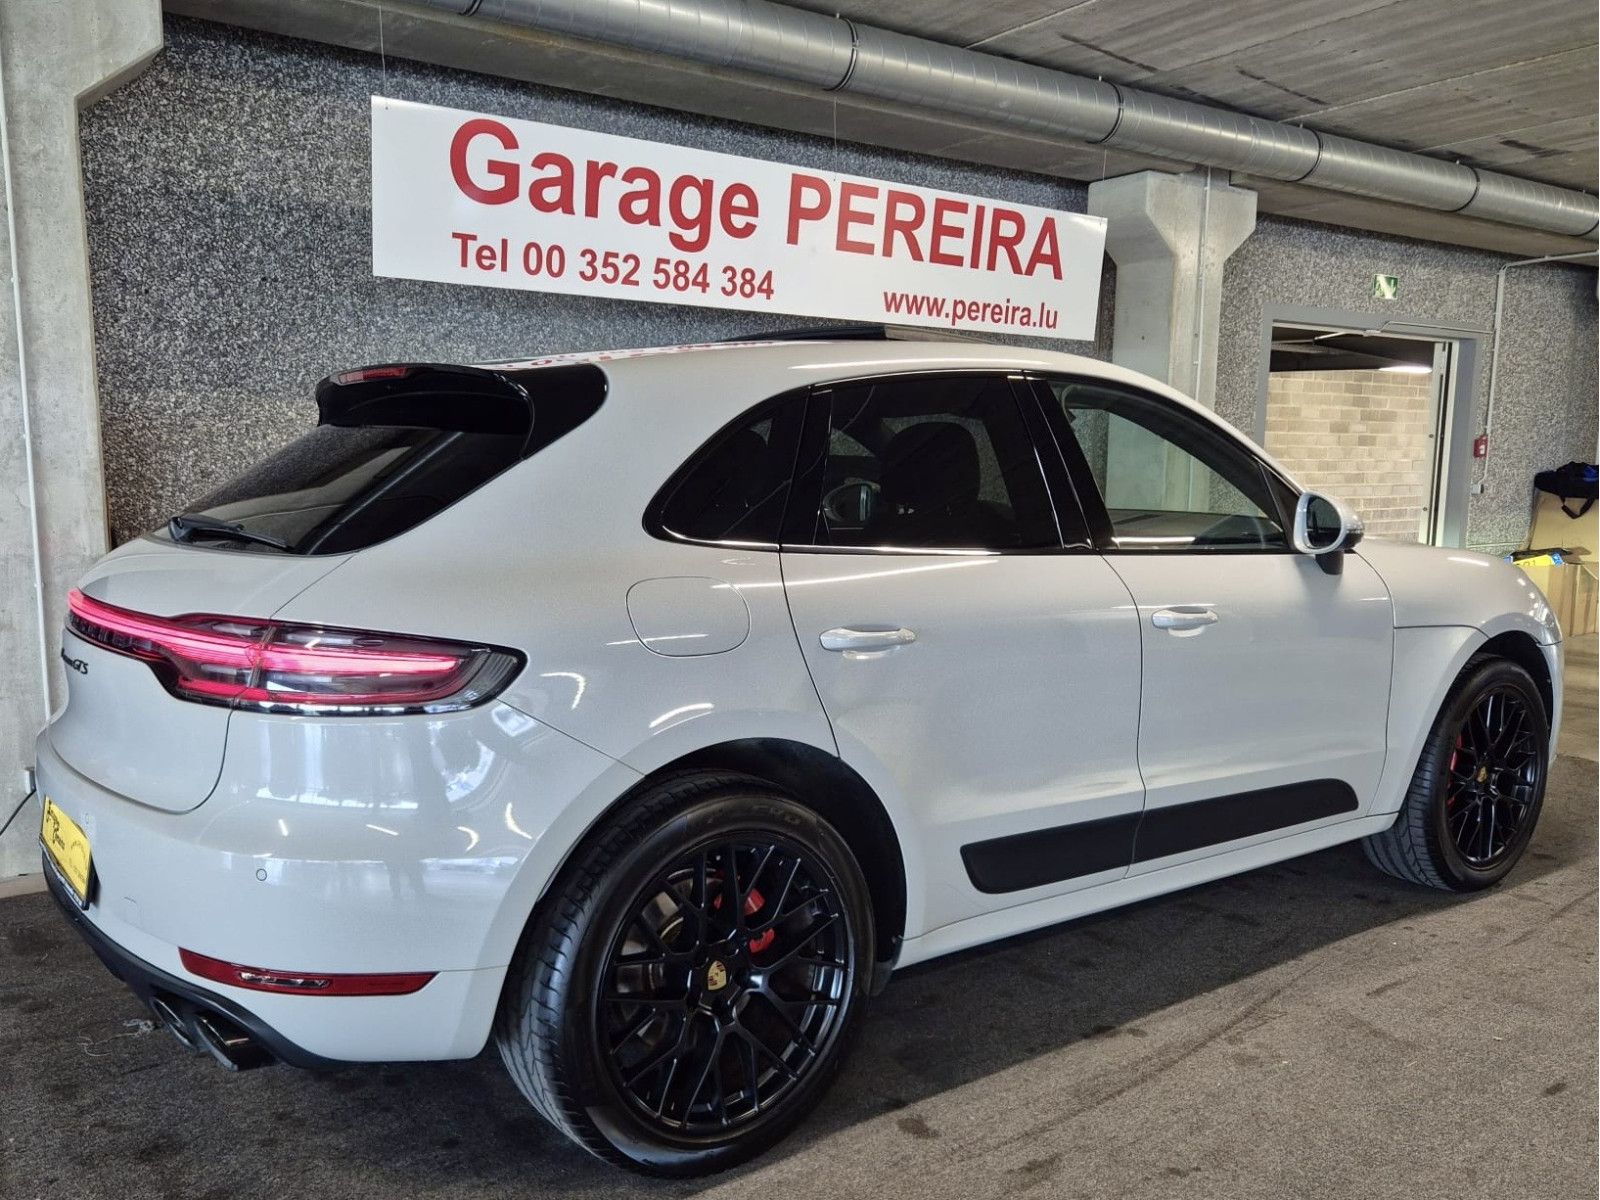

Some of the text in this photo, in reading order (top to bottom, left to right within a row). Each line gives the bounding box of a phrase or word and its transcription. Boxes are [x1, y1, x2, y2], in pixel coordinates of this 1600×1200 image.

[449, 118, 1064, 281] Garage PEREIRA
[451, 232, 775, 300] Tel 00 352 584 384
[883, 291, 1059, 330] www.pereira.lu
[72, 659, 89, 675] GTS
